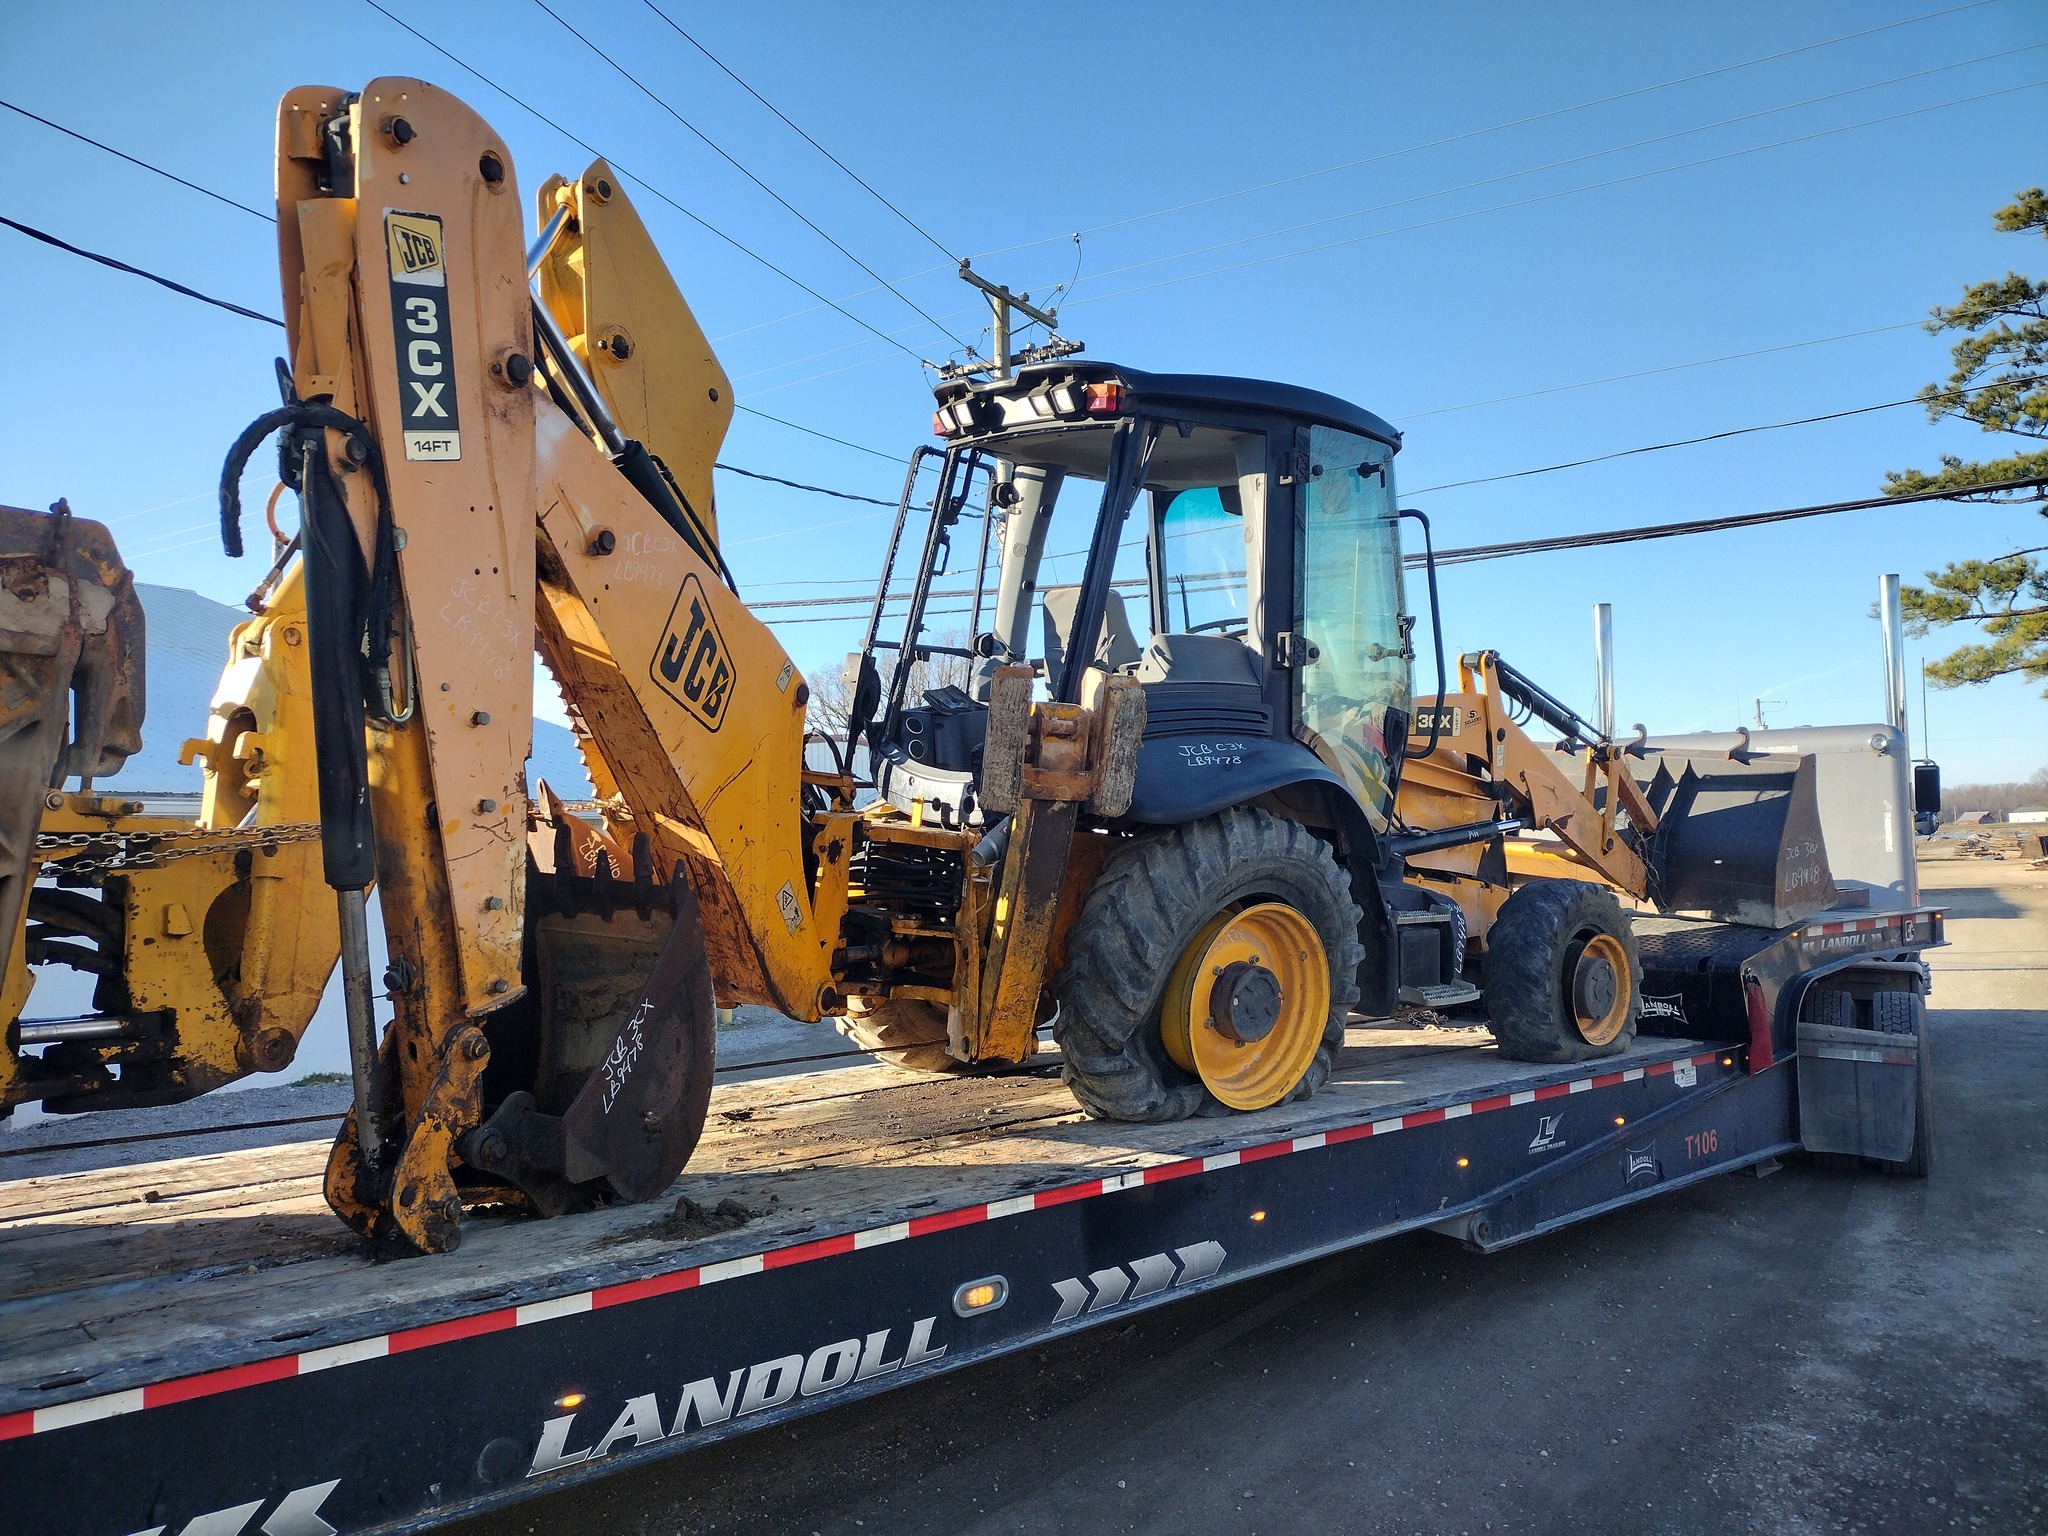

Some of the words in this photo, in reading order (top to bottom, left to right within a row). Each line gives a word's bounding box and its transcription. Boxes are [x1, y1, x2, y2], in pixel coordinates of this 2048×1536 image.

[400, 230, 436, 268] JCB
[405, 297, 448, 417] 3CX
[414, 440, 451, 452] 14FT
[615, 561, 666, 586] LB9478
[660, 596, 730, 719] JCB
[1179, 744, 1213, 757] JCB
[1216, 743, 1247, 751] C3X
[1188, 755, 1242, 767] LB9478
[1821, 933, 1868, 951] LANDOLL
[602, 1036, 628, 1080] JCB
[603, 1032, 644, 1114] LB9478
[1685, 1129, 1718, 1159] T106
[1629, 1154, 1653, 1174] LANDOLL
[526, 1316, 948, 1478] LANDOLL
